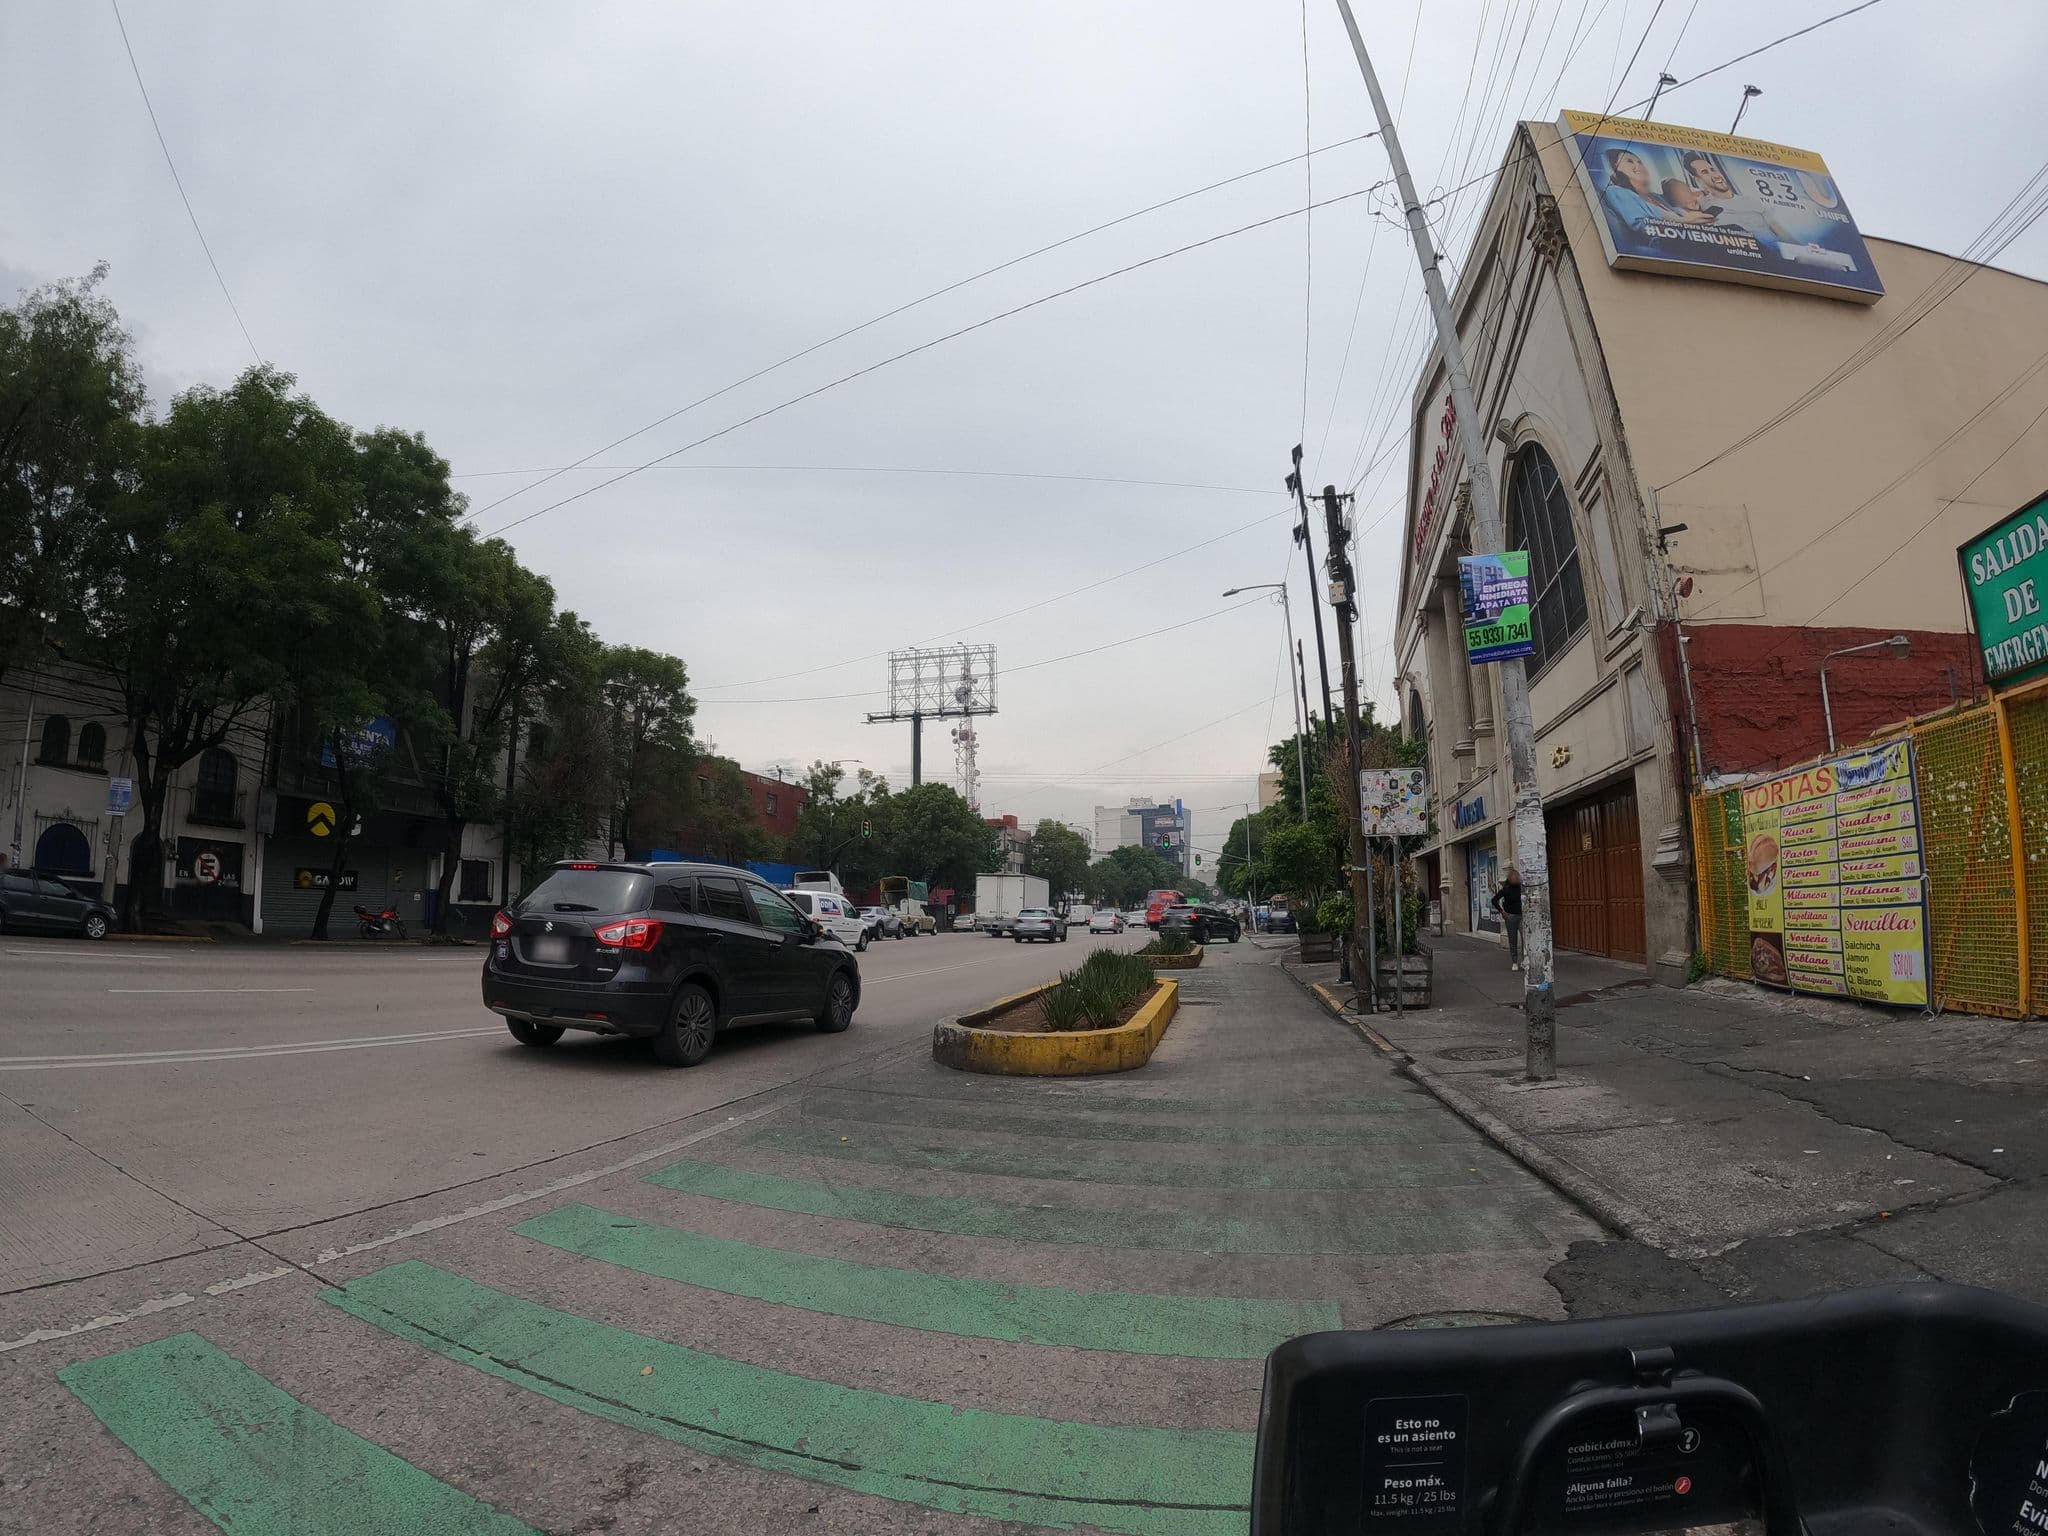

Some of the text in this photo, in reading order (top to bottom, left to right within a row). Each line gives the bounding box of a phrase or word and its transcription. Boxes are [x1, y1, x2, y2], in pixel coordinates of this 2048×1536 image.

[1572, 113, 1810, 161] UNA PROGRAMACIÓN DIFERENTE PARA
[1614, 127, 1781, 162] QUIEN QUIERE ALGO NUEVO
[1749, 168, 1790, 182] canal
[1756, 180, 1799, 202] 8.3
[1815, 210, 1850, 224] UNIFE
[1645, 225, 1760, 251] #LOVIENUNIFE
[1971, 514, 2048, 587] SALIDA
[1482, 579, 1528, 593] ENTREGA
[1479, 588, 1528, 602] INMEDIATA
[2002, 578, 2041, 624] DE
[1475, 600, 1510, 611] ZAPATA
[1469, 622, 1529, 647] 55 9337 7341
[1744, 766, 1832, 813] TORTAS
[1783, 803, 1824, 817] Cubana
[1839, 812, 1892, 829] Suadero
[1782, 828, 1816, 839] Rusa
[1840, 835, 1897, 850] Hawaiana
[1782, 849, 1818, 861] Pastor
[1841, 861, 1887, 872] Suiza
[1782, 869, 1821, 881] Pierna
[1785, 889, 1828, 900] Milanesa
[1842, 885, 1902, 897] Italiana
[1785, 910, 1829, 921] Napolitana
[1845, 911, 1917, 931] Sencillas
[1787, 932, 1829, 943] Norteña
[1844, 940, 1881, 951] Salchicha
[1788, 953, 1830, 966] Poblana
[1846, 952, 1870, 963] Jamon
[1847, 964, 1869, 974] Huevo
[1857, 976, 1883, 987] Blanco
[1859, 989, 1889, 1001] Amarillo
[1395, 1419, 1441, 1430] Esto no
[1377, 1430, 1457, 1443] es un asiento
[1390, 1446, 1404, 1454] This
[1411, 1445, 1422, 1453] not
[1385, 1474, 1445, 1489] Peso máx.
[1566, 1476, 1633, 1496] ¿Alguna falla?
[1374, 1490, 1457, 1506] 11.5 kg / 25 lbs
